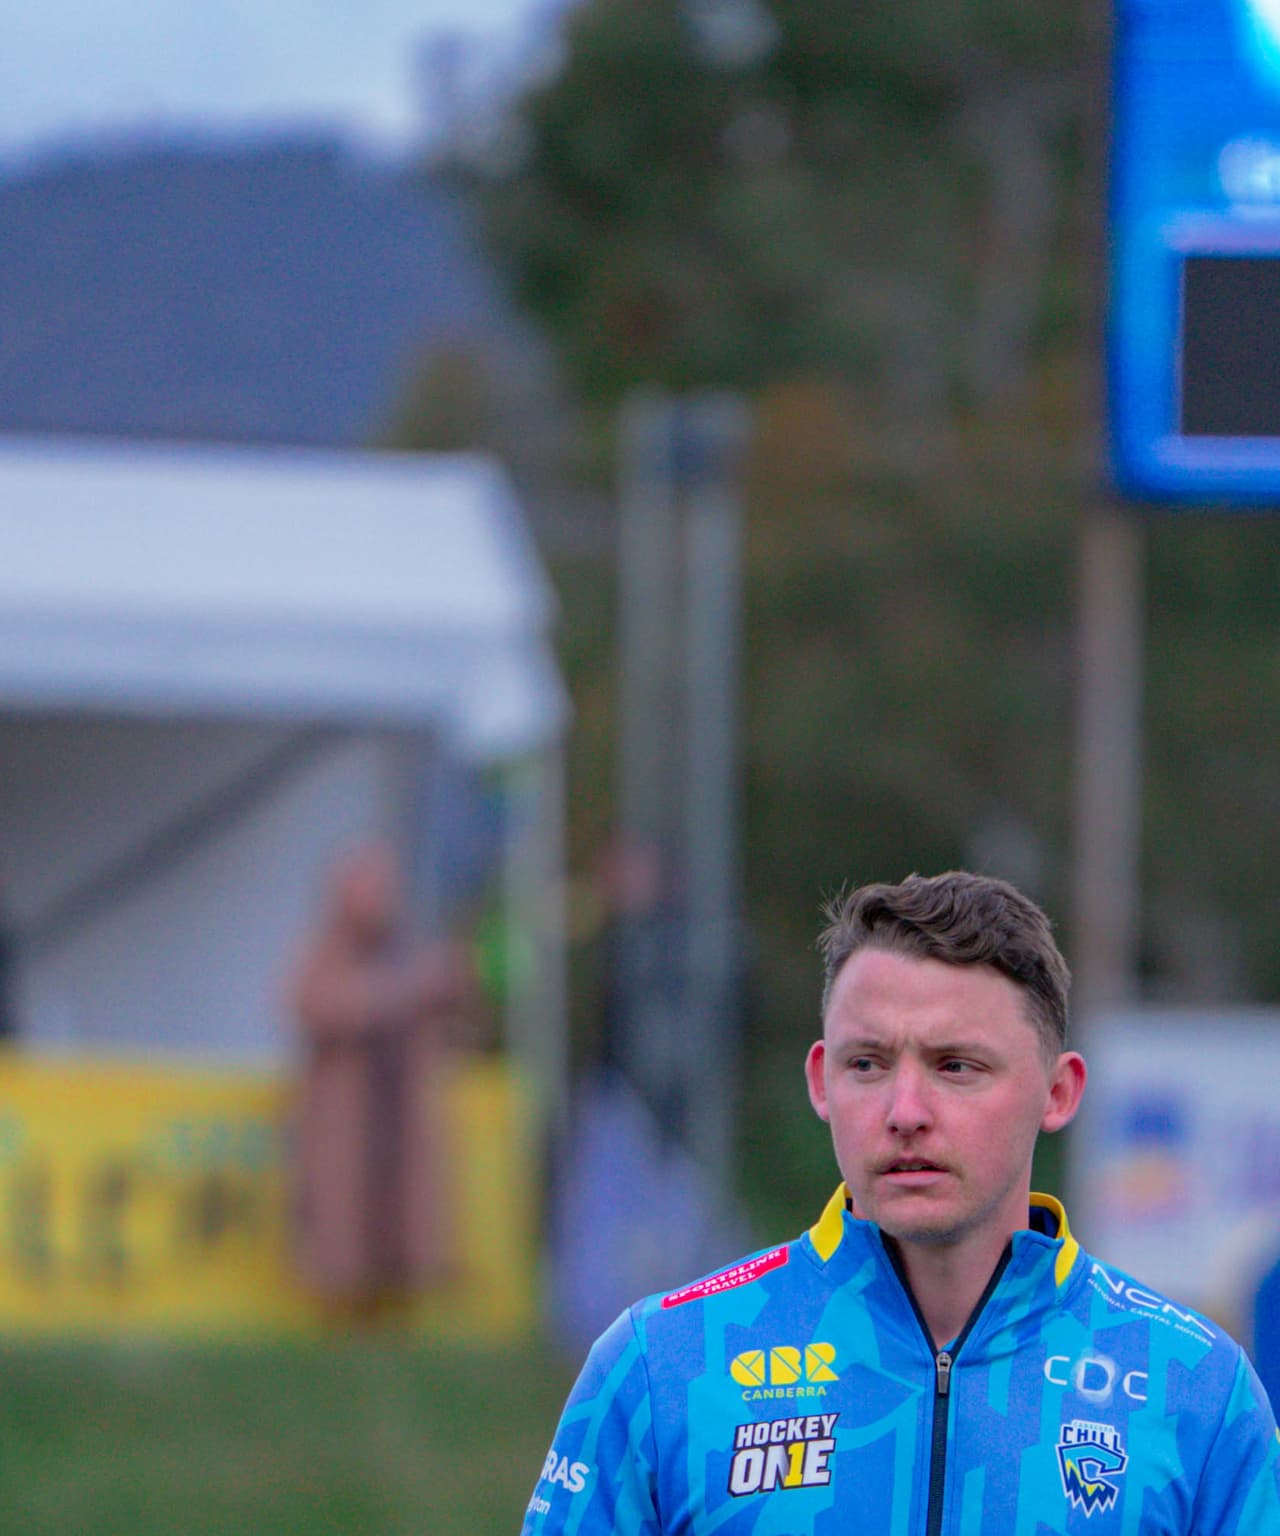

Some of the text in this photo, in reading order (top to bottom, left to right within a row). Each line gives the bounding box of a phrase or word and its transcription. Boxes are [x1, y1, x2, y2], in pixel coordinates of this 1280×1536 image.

[668, 1250, 782, 1301] SPORTSLINK
[702, 1272, 756, 1294] TRAVEL
[742, 1386, 827, 1401] CANBERRA
[1044, 1355, 1149, 1401] CDC
[736, 1414, 838, 1449] HOCKEY
[1062, 1426, 1125, 1454] CHILL
